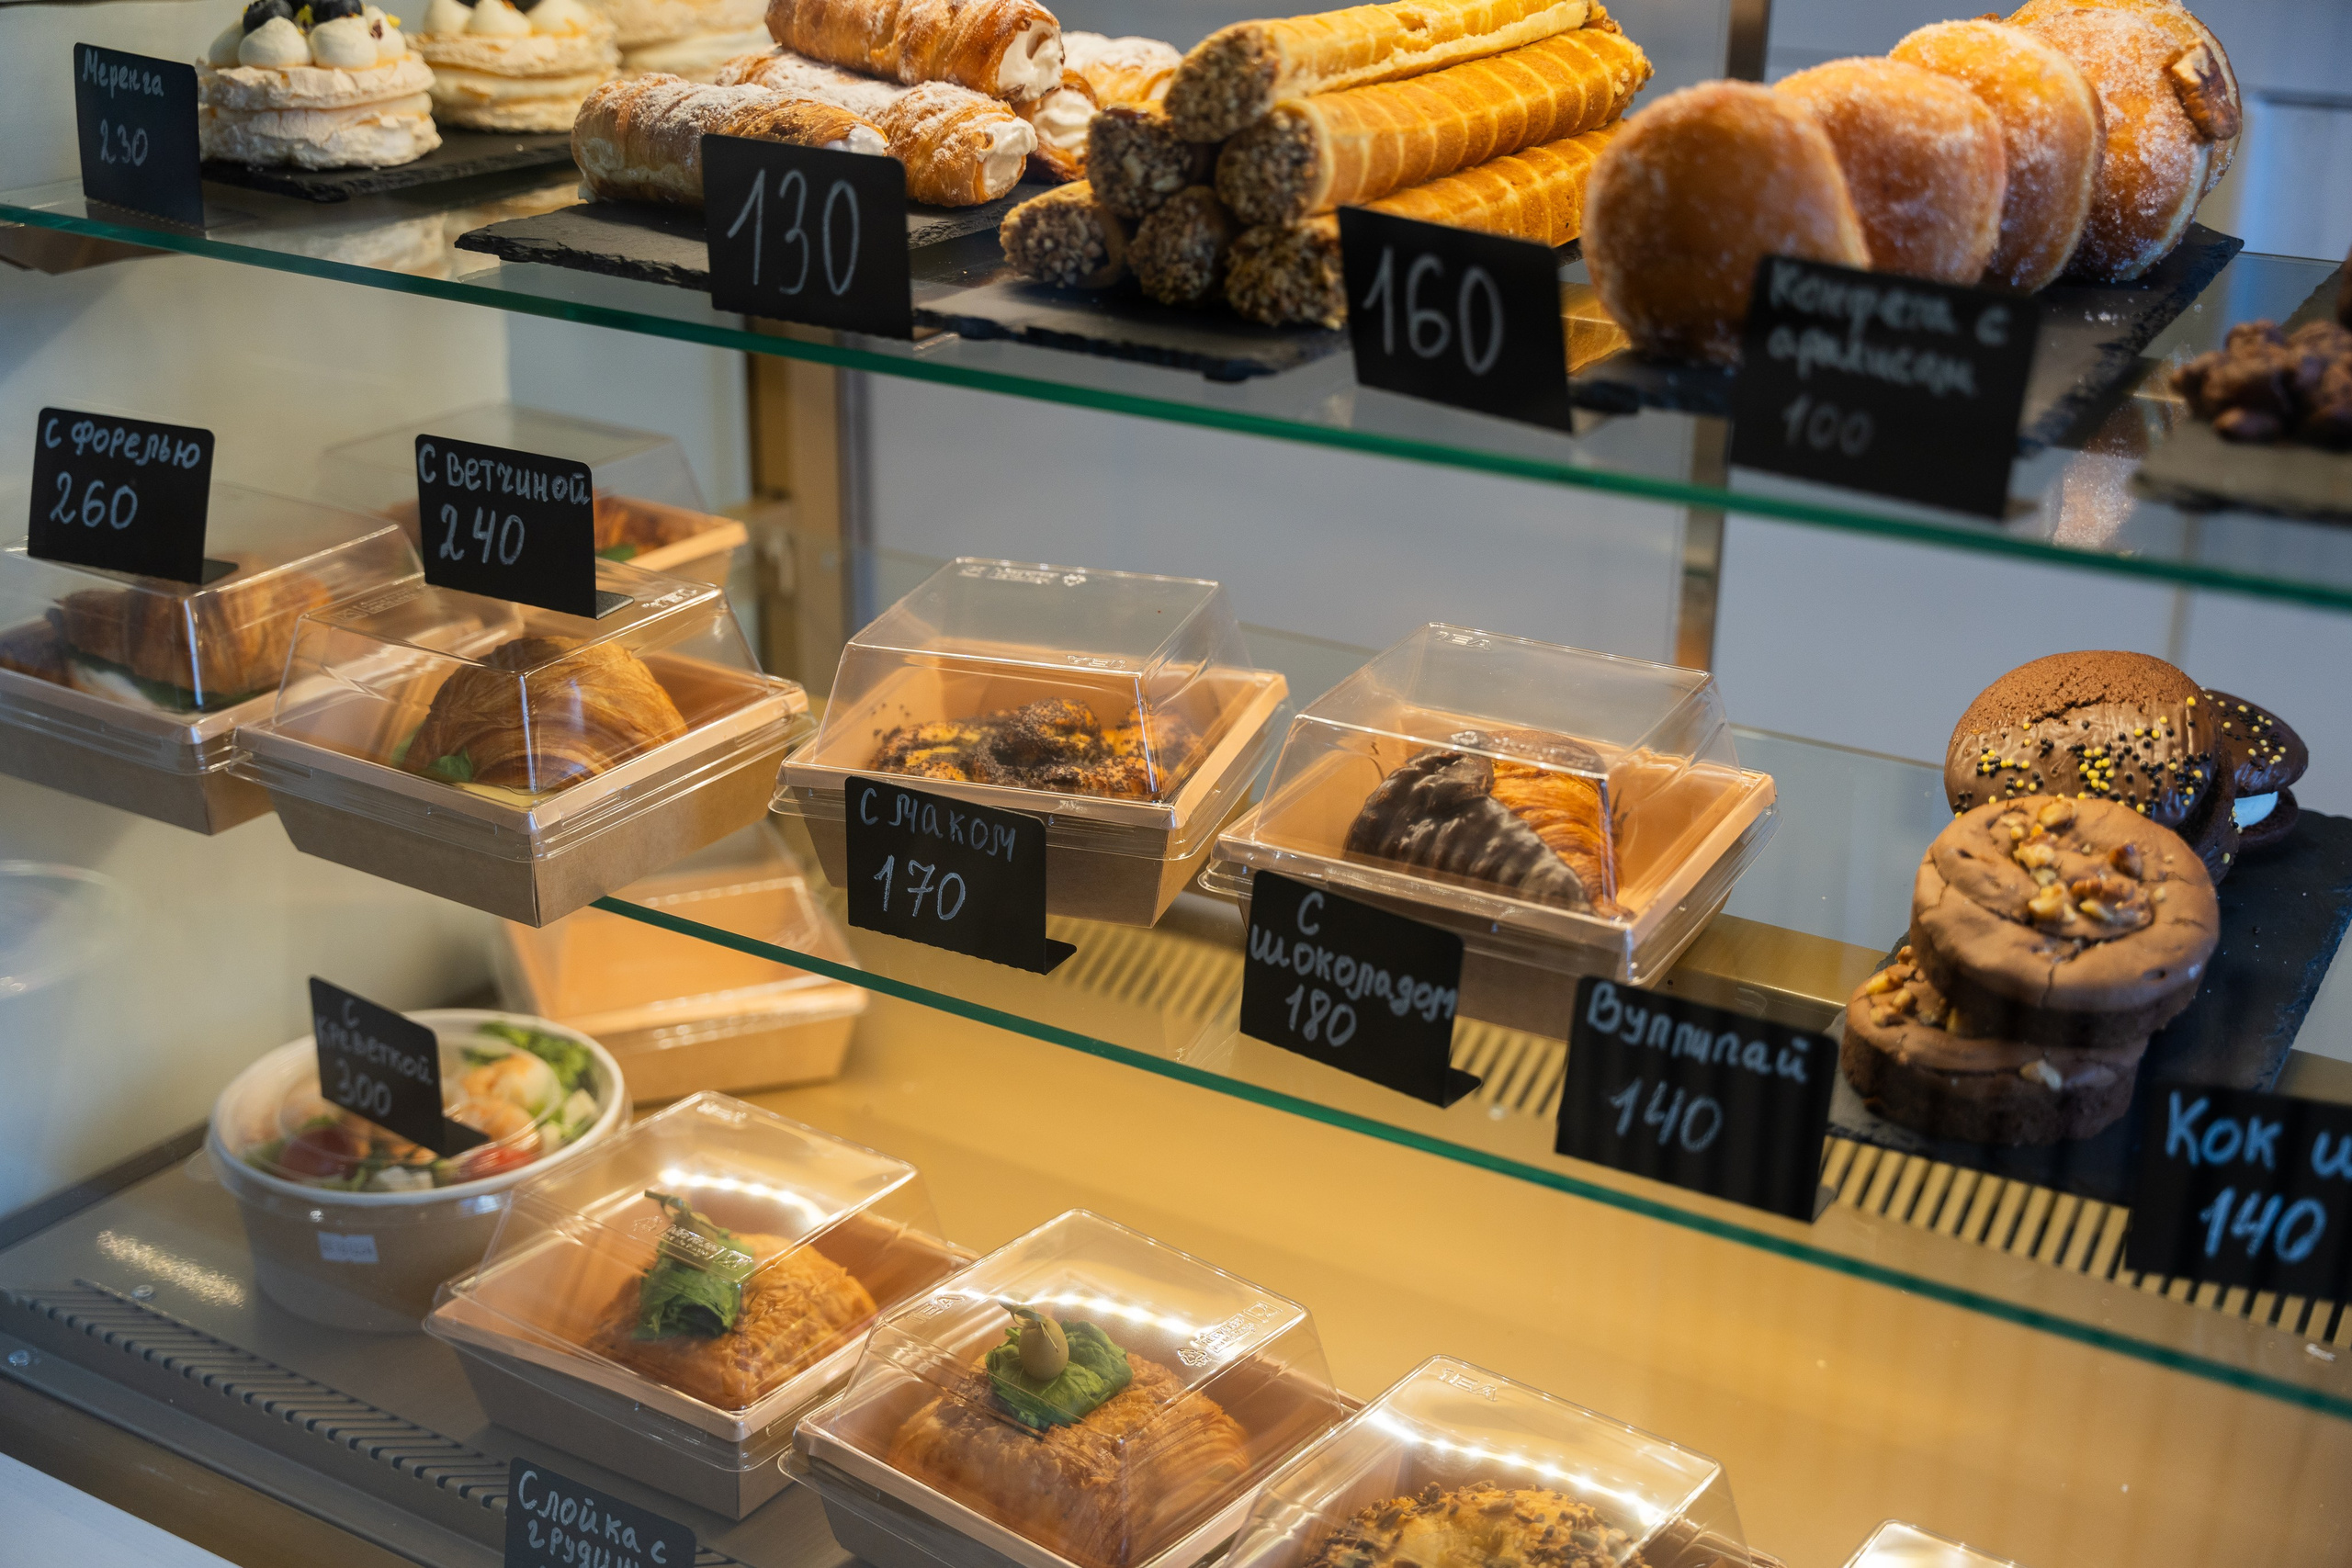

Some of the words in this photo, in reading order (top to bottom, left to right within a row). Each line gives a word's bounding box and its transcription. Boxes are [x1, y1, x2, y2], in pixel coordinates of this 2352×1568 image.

[82, 48, 164, 98] Меренга
[100, 118, 149, 166] 230
[727, 168, 860, 296] 130
[1363, 243, 1505, 377] 160
[1781, 393, 1875, 457] 100
[49, 470, 139, 531] 260
[439, 502, 526, 566] 240
[873, 854, 966, 920] 170
[1285, 983, 1358, 1048] 180
[335, 1057, 392, 1117] 300
[1611, 1077, 1724, 1153] 140
[2199, 1186, 2328, 1264] 140
[518, 1470, 641, 1554] Слойка
